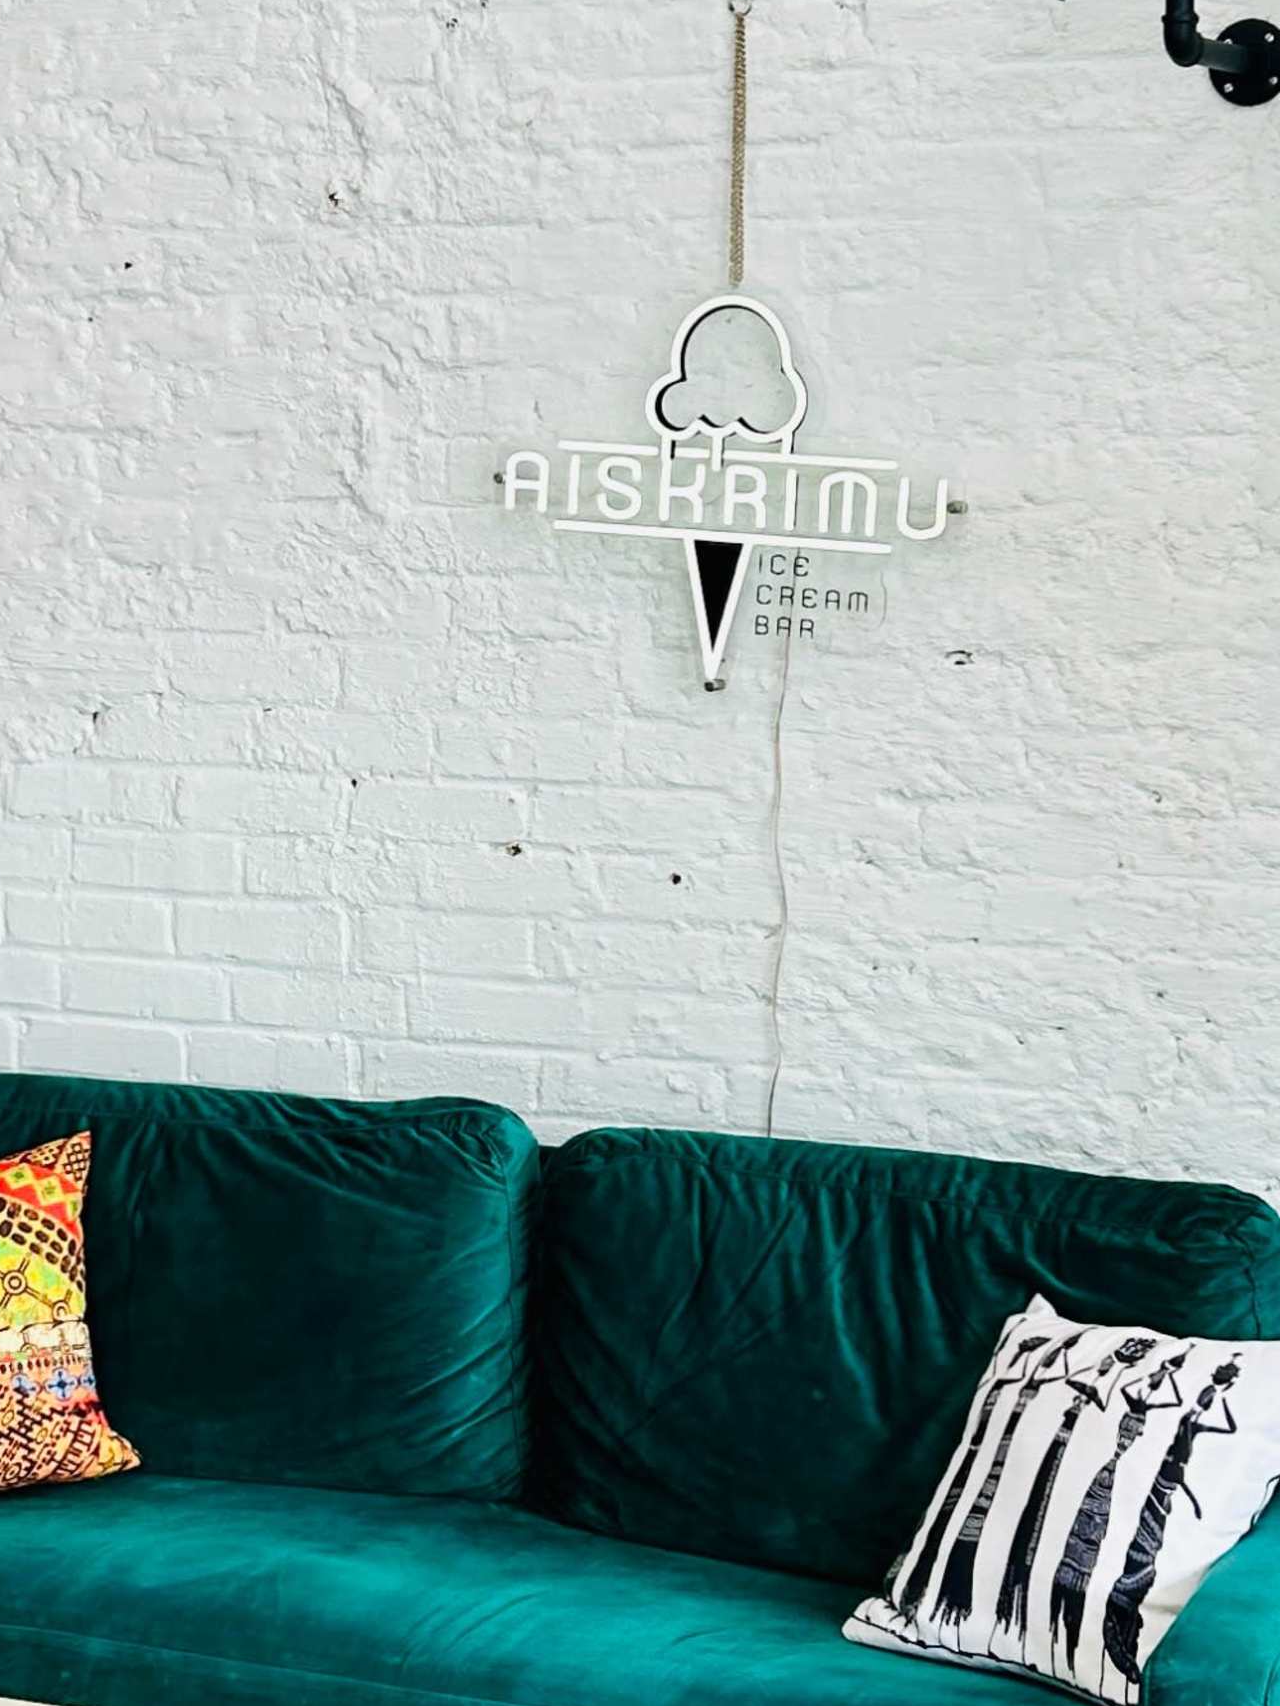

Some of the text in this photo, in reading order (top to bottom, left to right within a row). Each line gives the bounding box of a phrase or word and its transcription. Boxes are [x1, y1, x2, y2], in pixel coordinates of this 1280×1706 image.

[504, 451, 947, 540] AISKRIMU
[757, 553, 810, 578] ICE
[755, 585, 869, 614] CREAM
[754, 616, 815, 639] BAR
